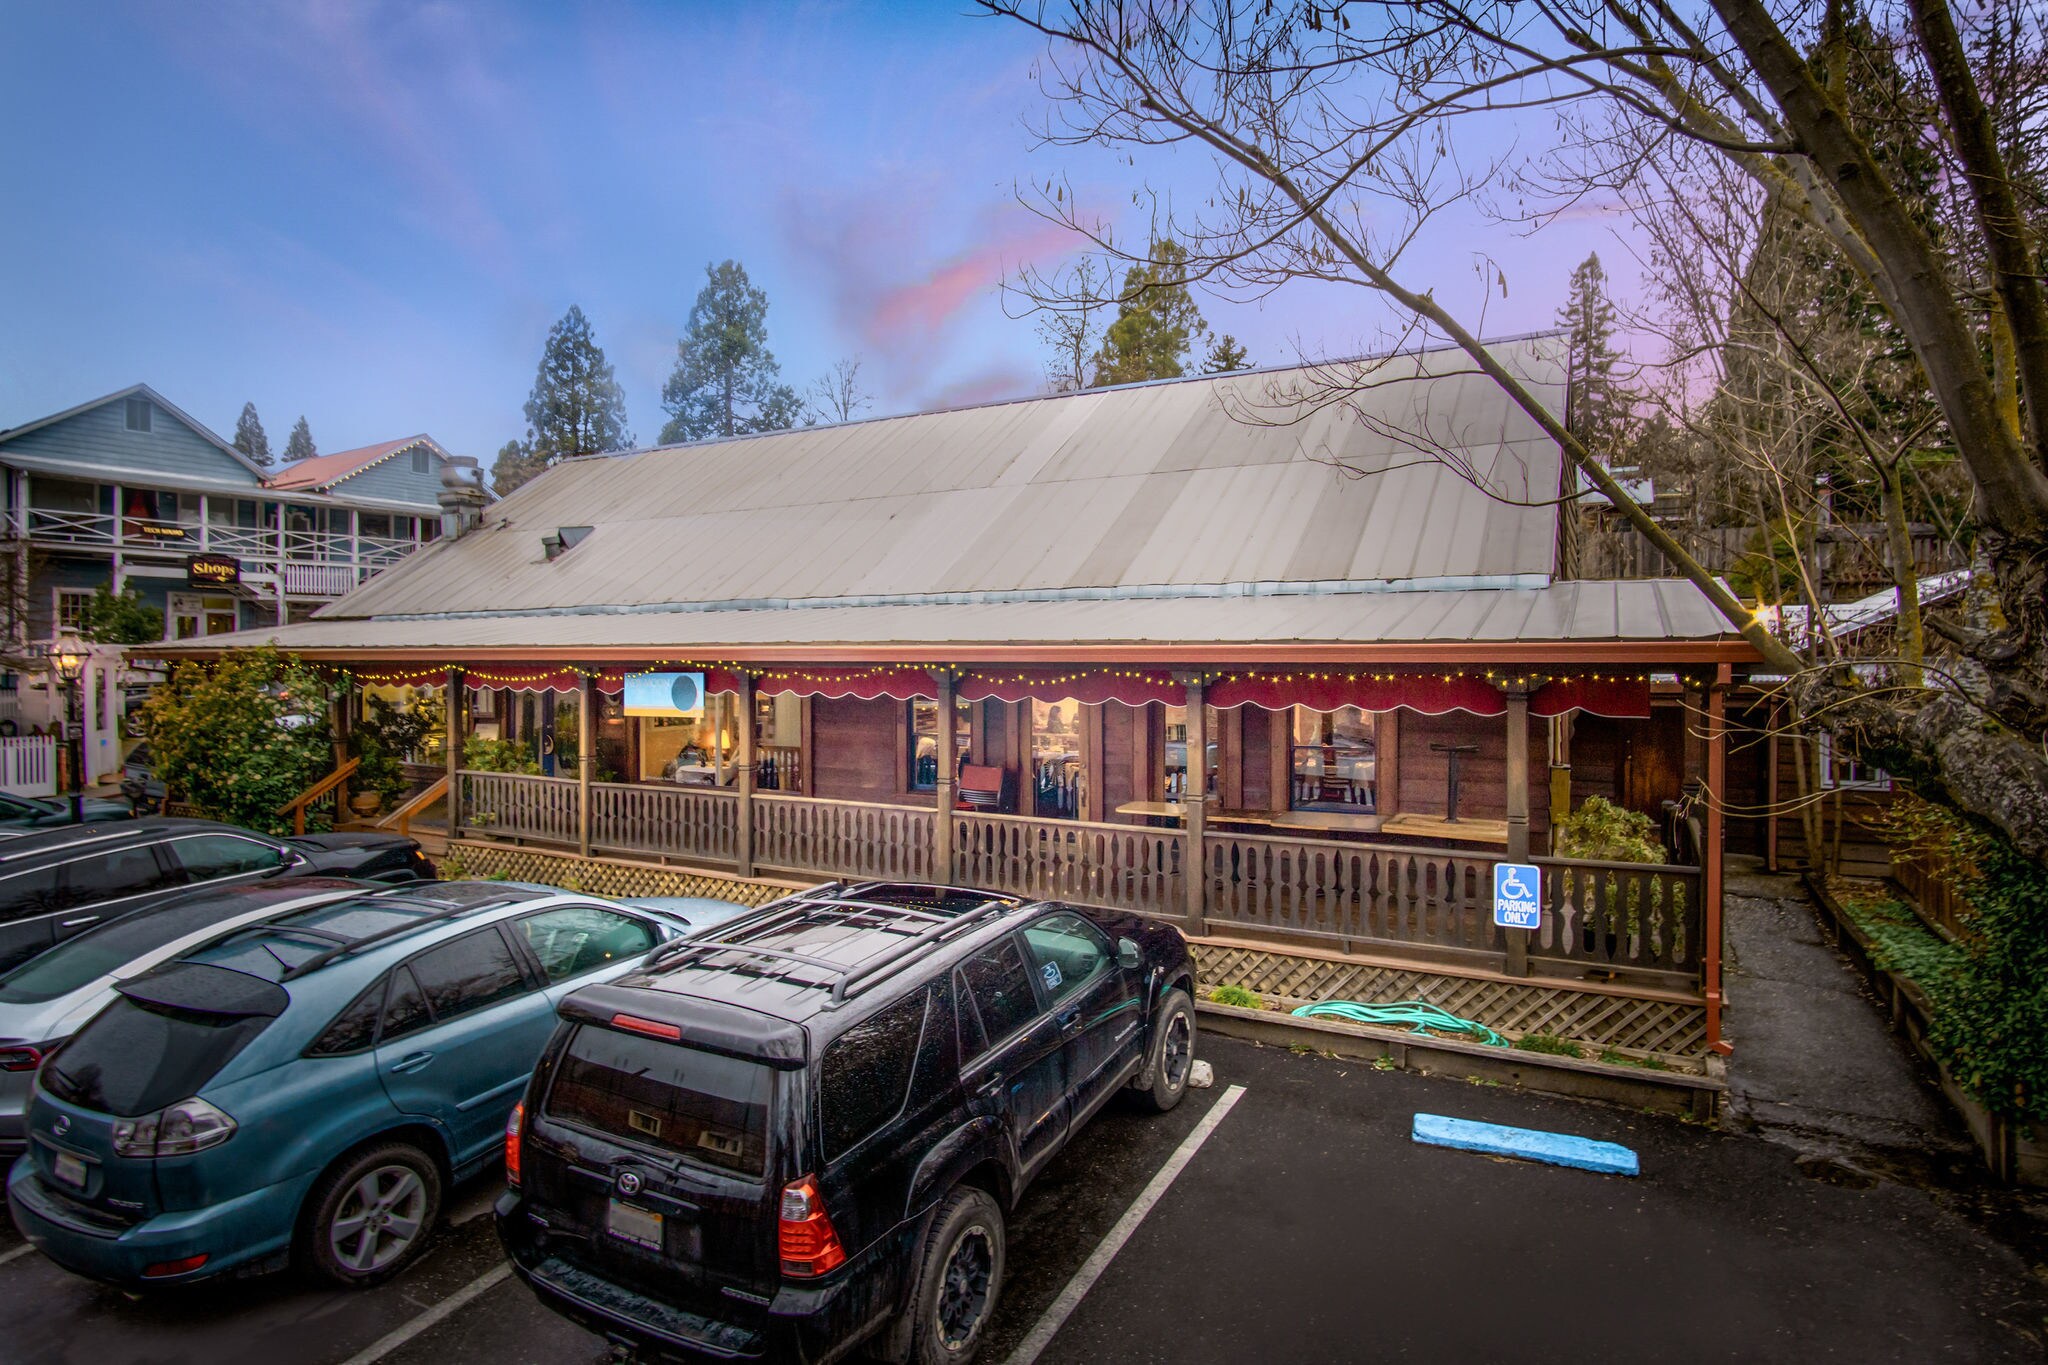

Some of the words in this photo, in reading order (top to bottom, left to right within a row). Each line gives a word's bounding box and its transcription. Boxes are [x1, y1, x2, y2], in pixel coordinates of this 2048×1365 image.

[193, 562, 236, 576] Shops
[1498, 899, 1536, 914] PARKING
[1504, 912, 1529, 924] ONLY
